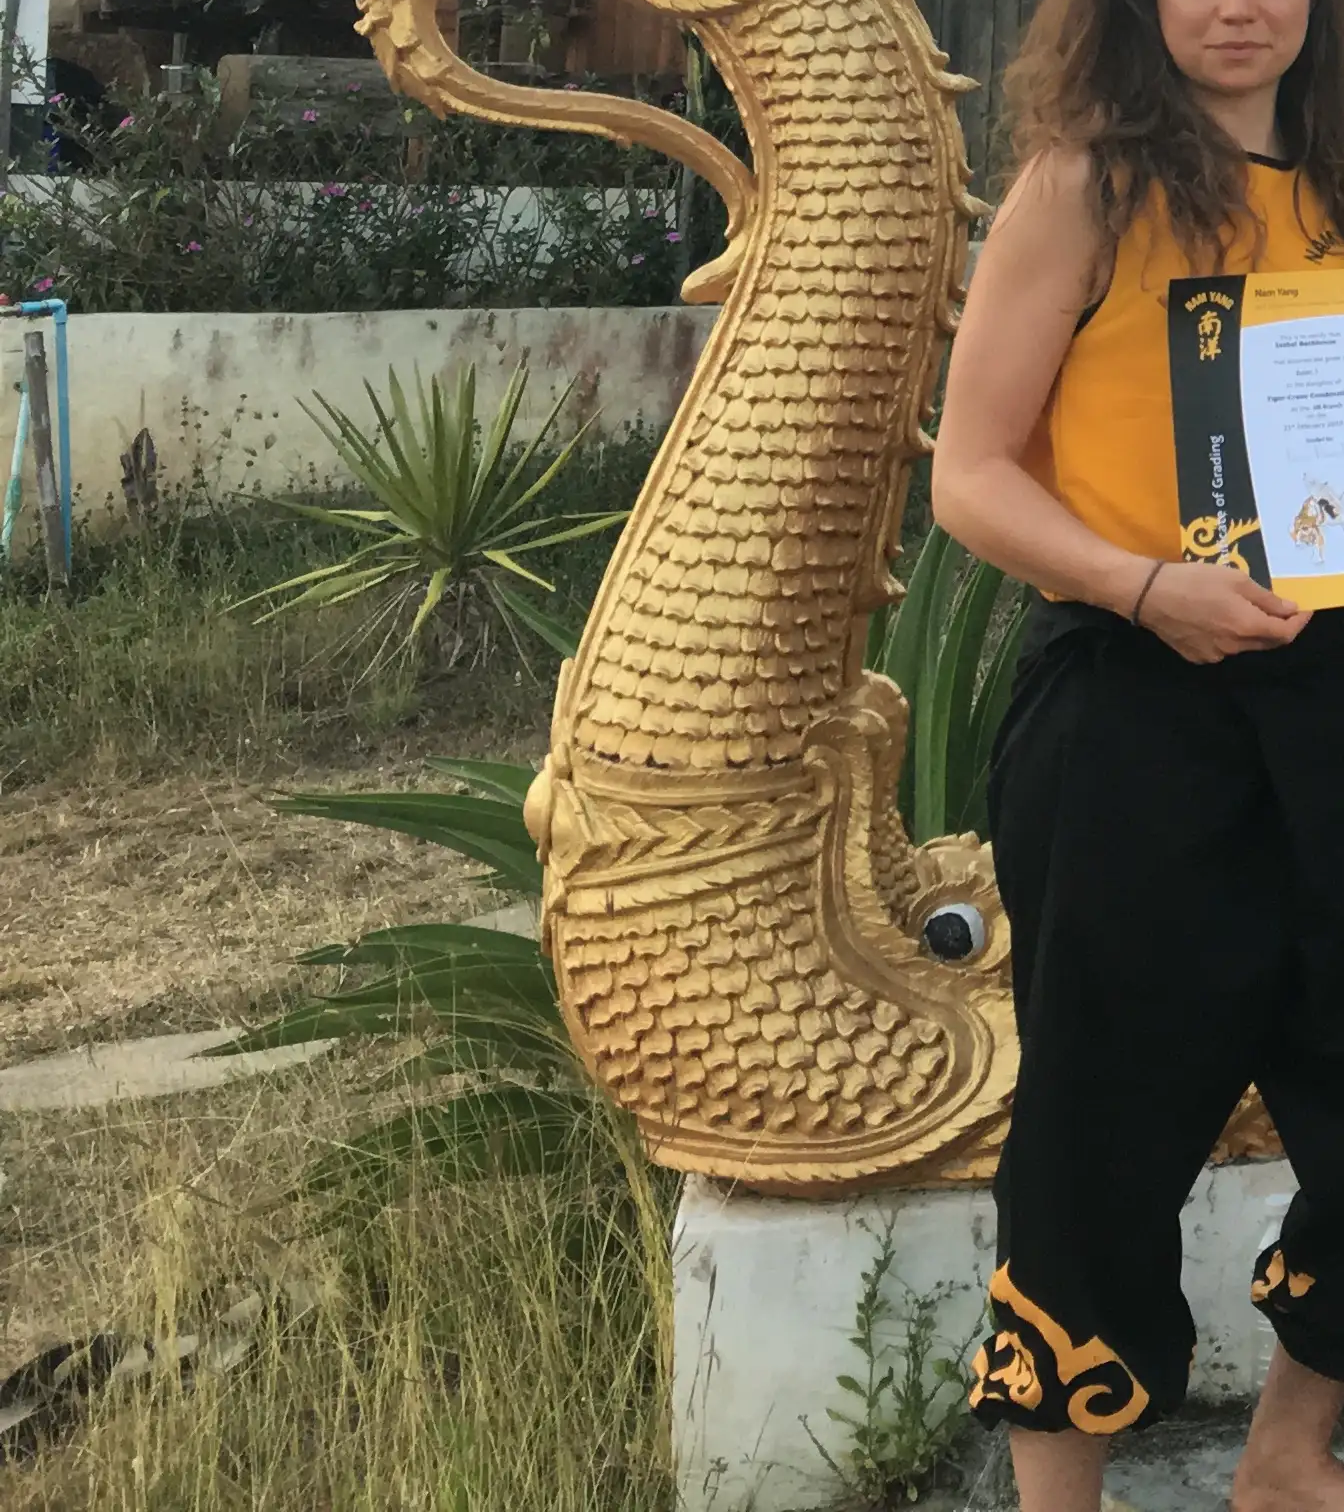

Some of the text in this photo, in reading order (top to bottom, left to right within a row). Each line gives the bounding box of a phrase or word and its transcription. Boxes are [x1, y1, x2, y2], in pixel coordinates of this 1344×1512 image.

[1303, 229, 1338, 265] NAM
[1184, 292, 1207, 312] NAM
[1209, 291, 1234, 310] YANG
[1198, 310, 1222, 361] 南洋
[1209, 434, 1225, 489] Grading
[1212, 491, 1225, 507] of
